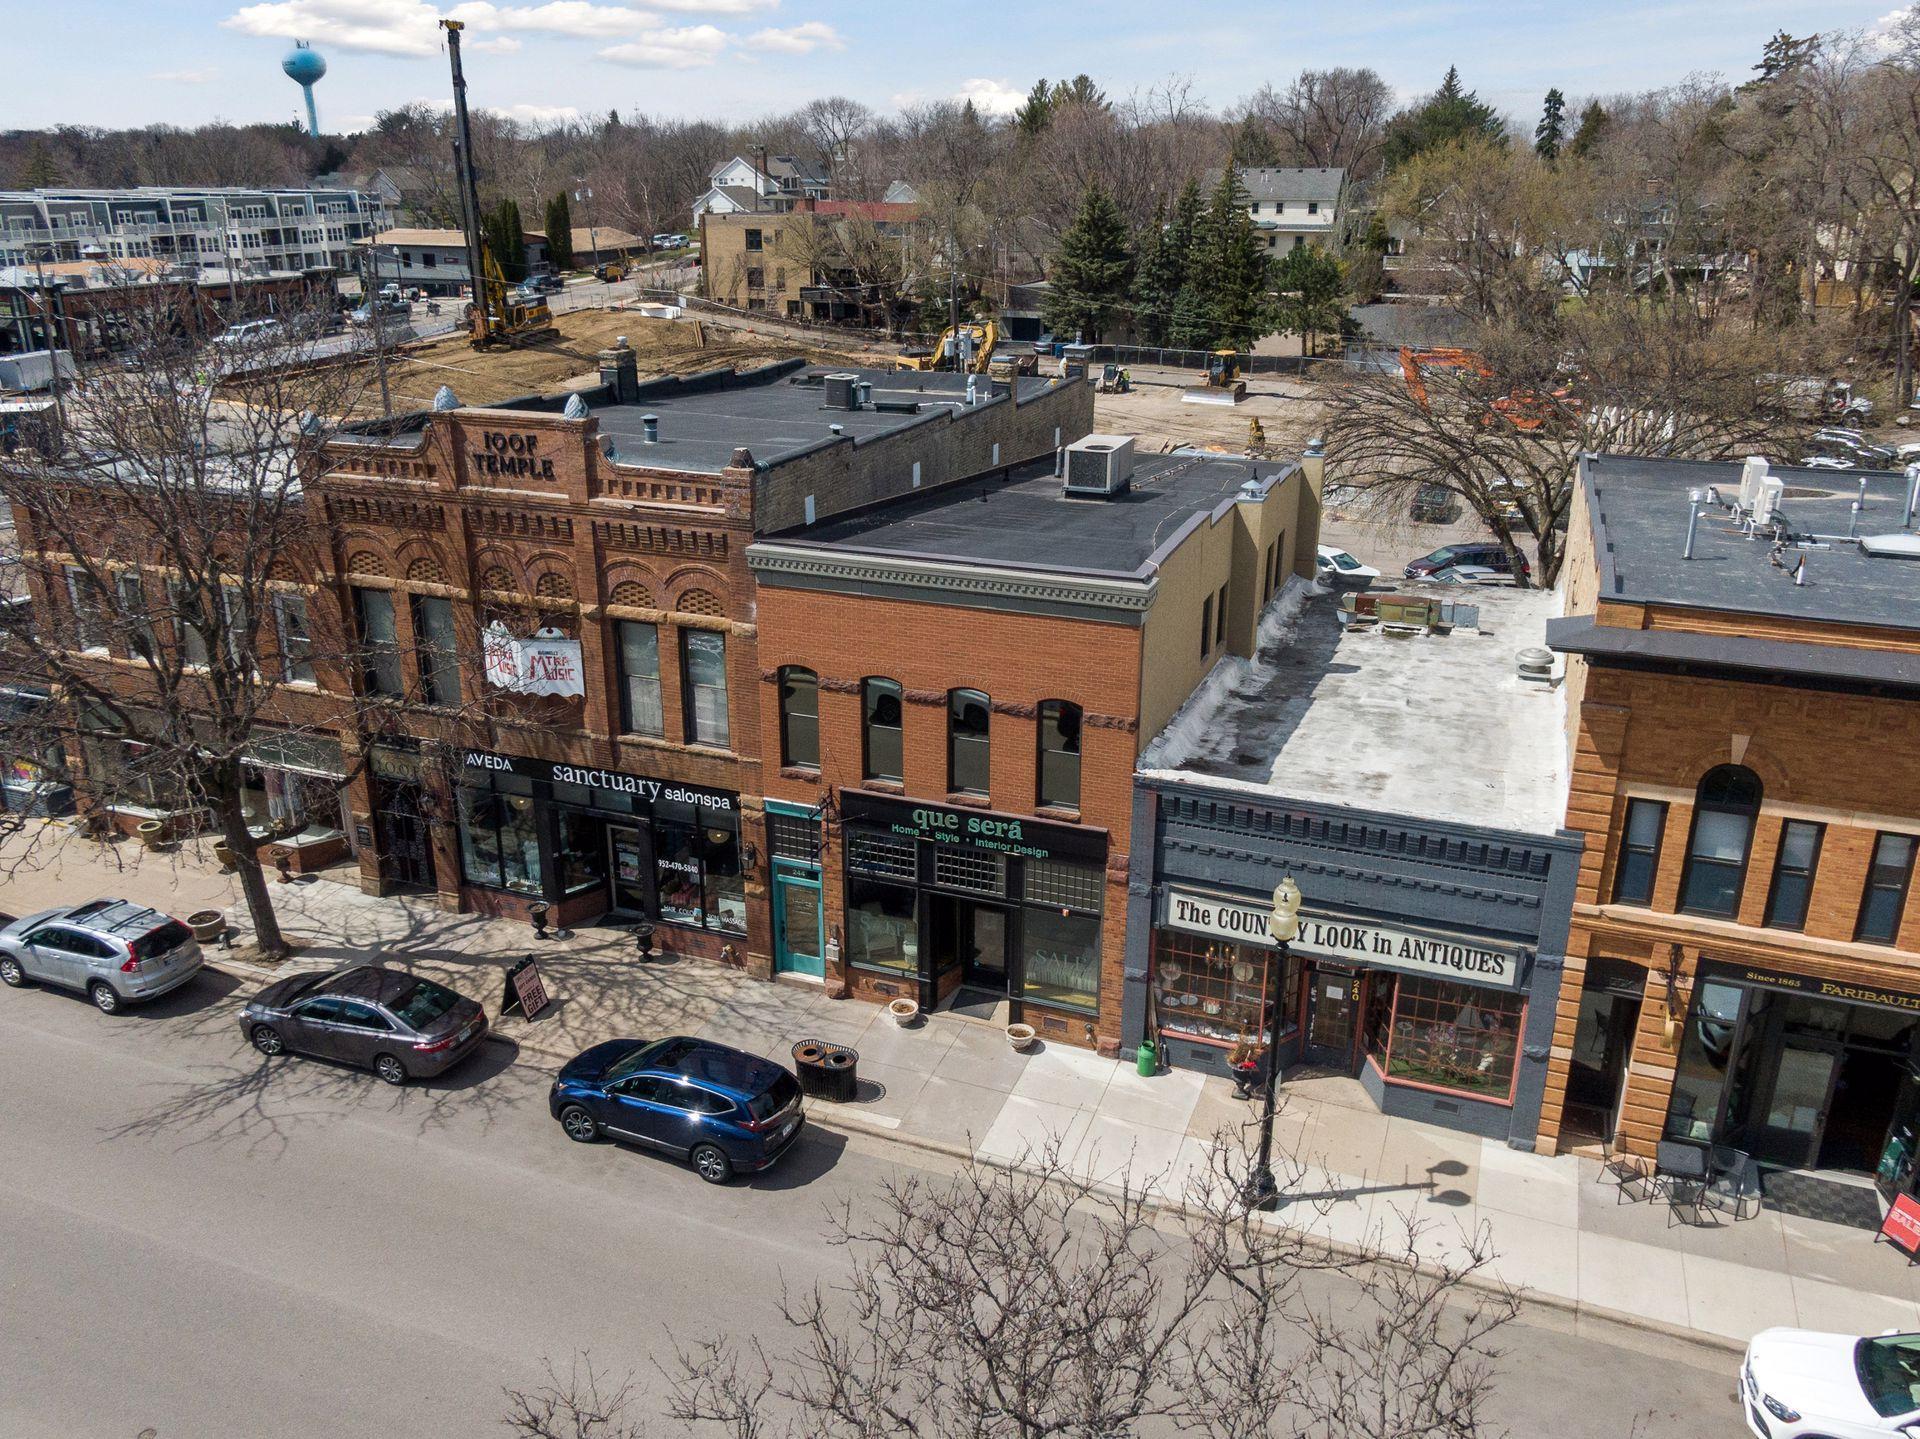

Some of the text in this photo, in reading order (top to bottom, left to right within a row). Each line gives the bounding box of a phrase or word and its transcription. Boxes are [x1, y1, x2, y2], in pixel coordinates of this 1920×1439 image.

[484, 431, 538, 454] IOOF
[473, 453, 556, 481] TEMPLE
[466, 753, 513, 772] AVEDA
[552, 764, 731, 811] sanctuary salonspa
[912, 808, 1024, 841] que será
[891, 823, 1049, 858] Home Style Interior Design
[1176, 900, 1506, 976] The COUNY LOOK in ANTIQUES
[1745, 971, 1776, 984] Since
[522, 985, 542, 1006] FREE
[1352, 980, 1360, 1001] 240
[527, 994, 544, 1014] GIFT
